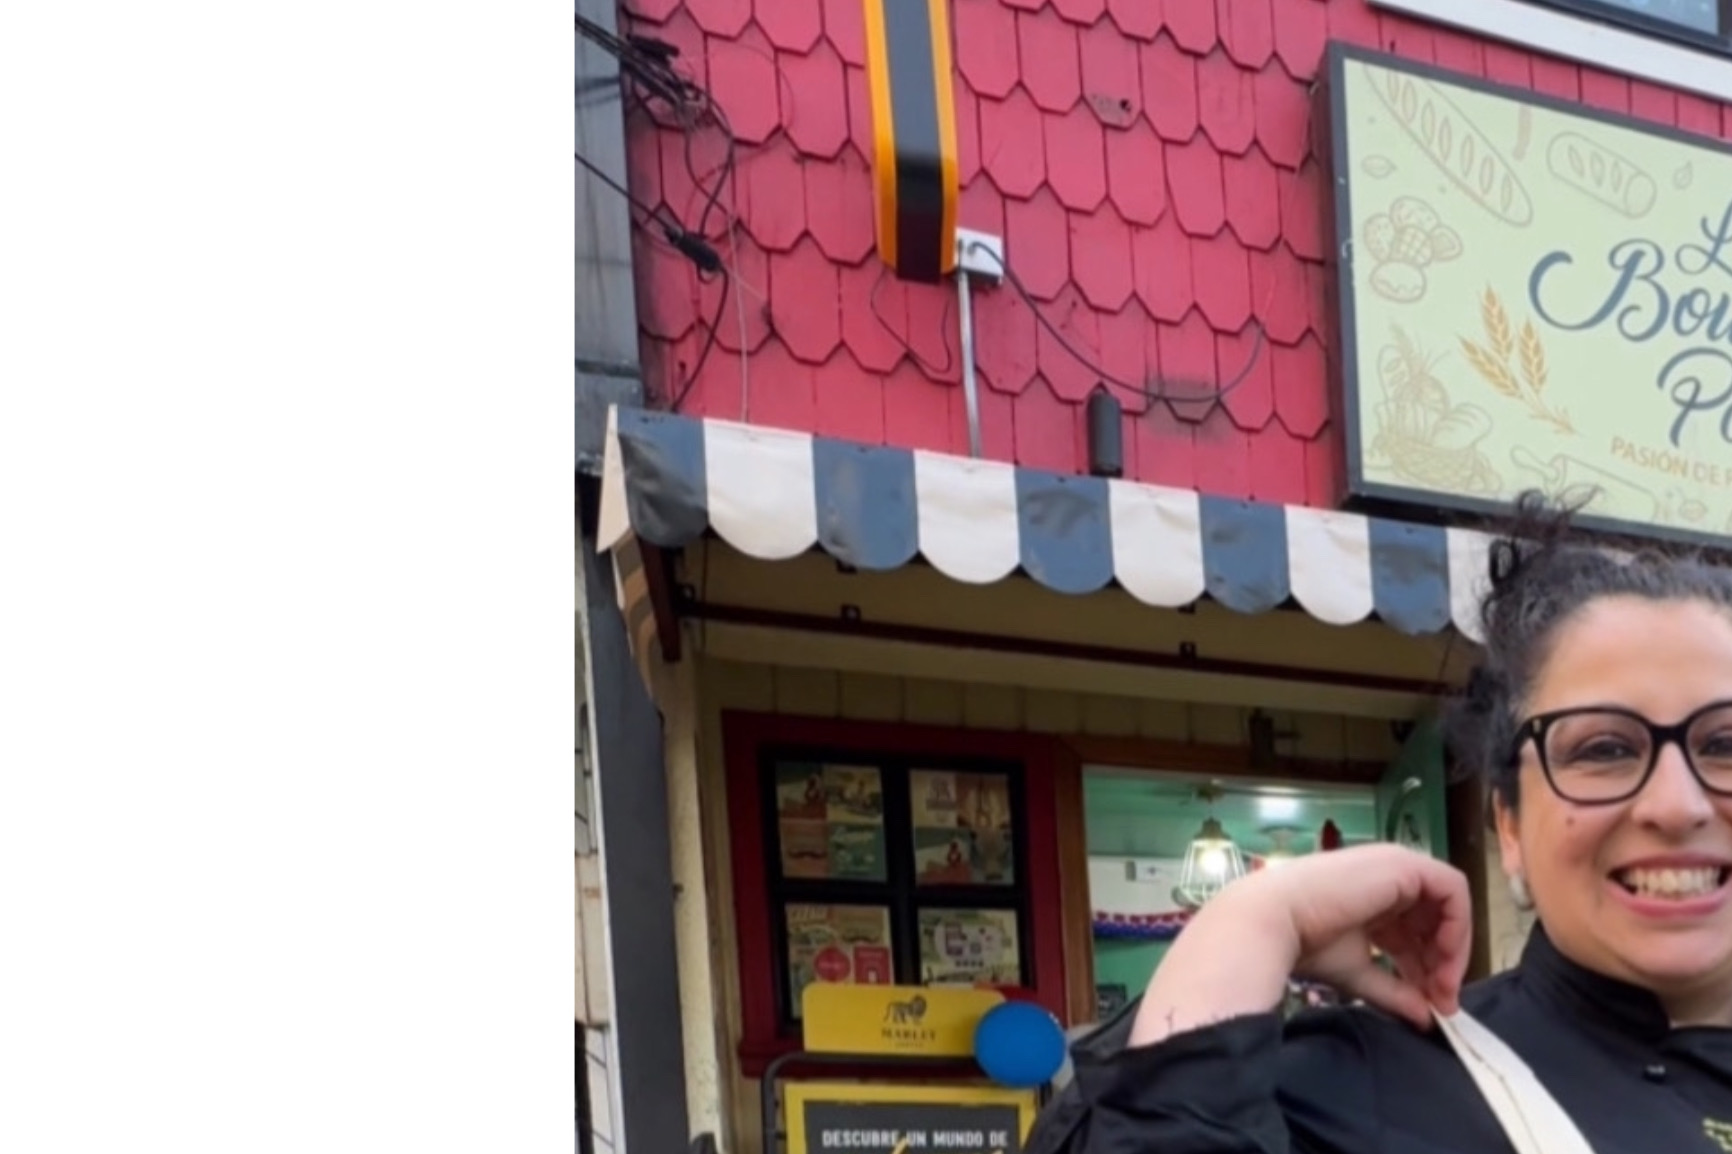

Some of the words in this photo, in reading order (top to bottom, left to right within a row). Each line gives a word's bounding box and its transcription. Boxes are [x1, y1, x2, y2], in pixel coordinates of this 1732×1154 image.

[1610, 436, 1689, 479] PASIÓN
[1694, 461, 1723, 487] DE
[821, 1129, 900, 1148] DESCUBRE
[905, 1130, 928, 1148] UN
[932, 1130, 984, 1147] MUNDO
[989, 1130, 1009, 1147] DE
